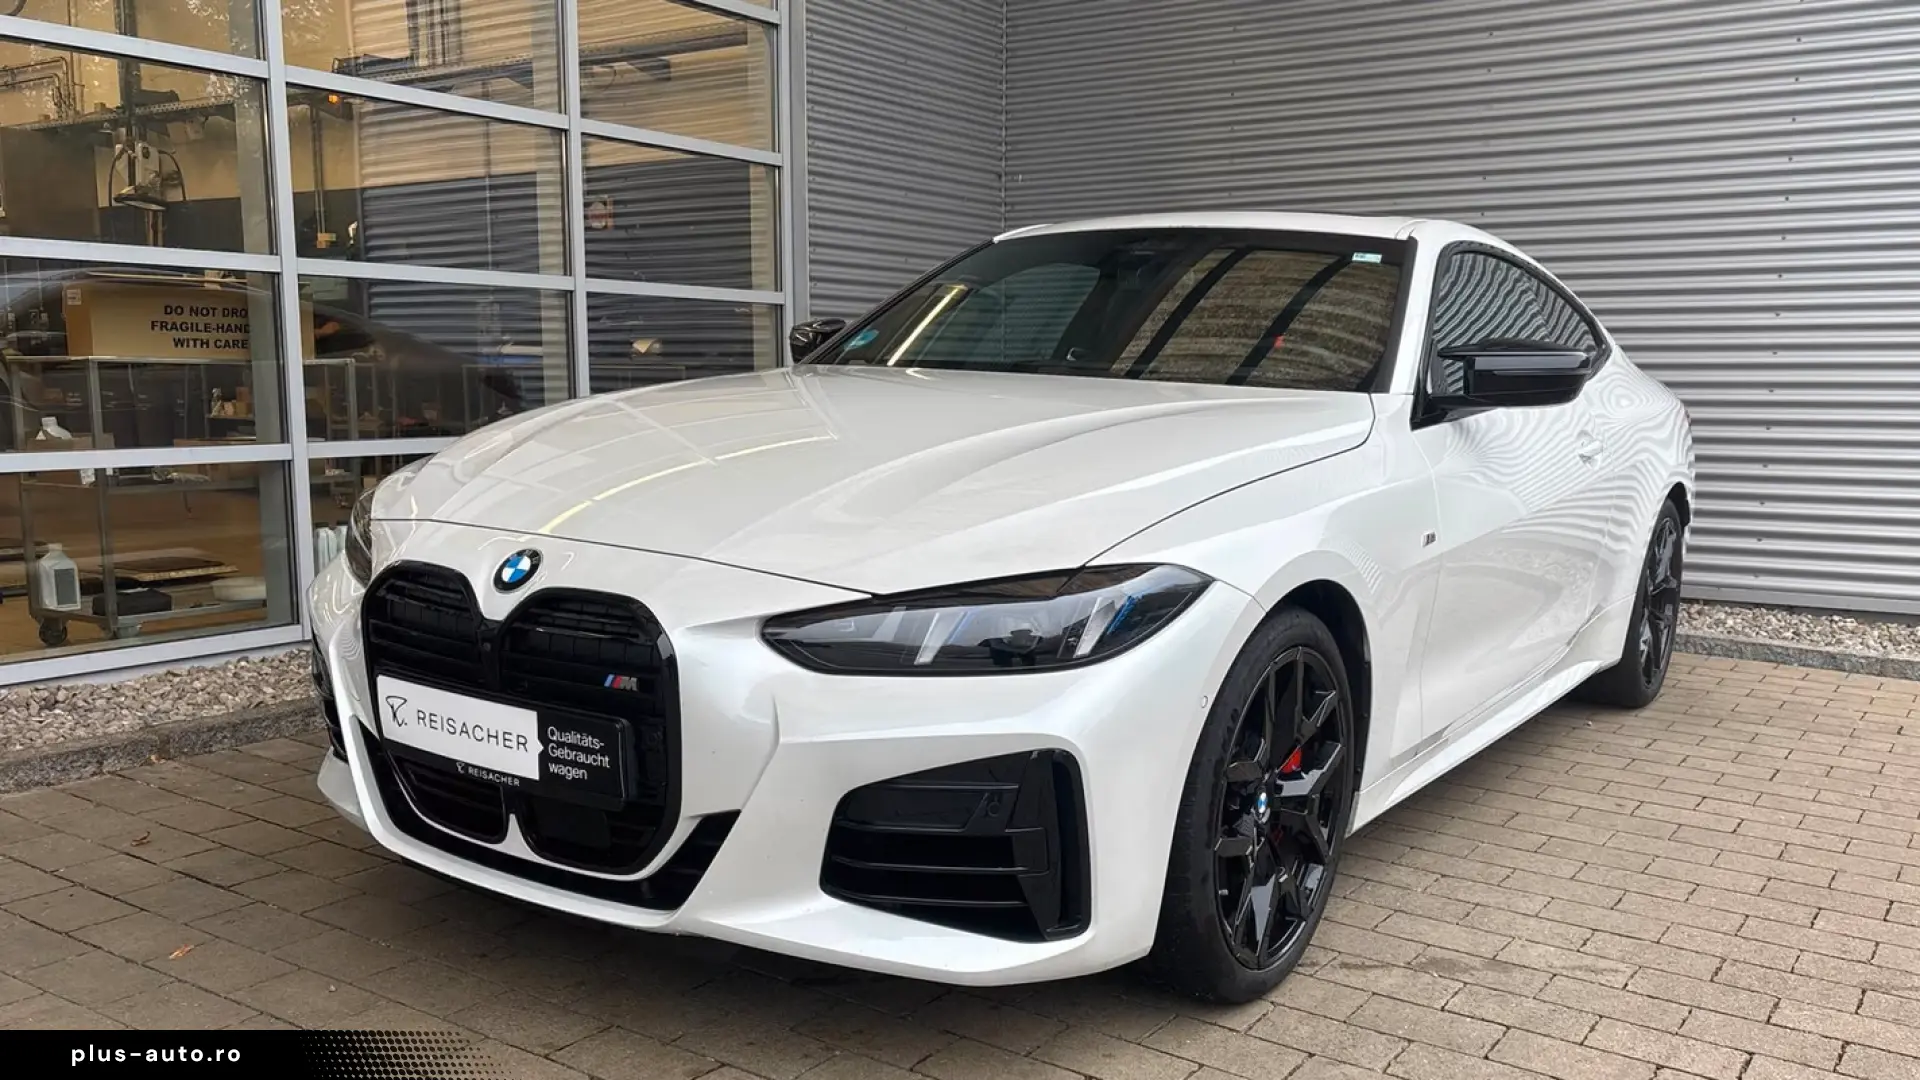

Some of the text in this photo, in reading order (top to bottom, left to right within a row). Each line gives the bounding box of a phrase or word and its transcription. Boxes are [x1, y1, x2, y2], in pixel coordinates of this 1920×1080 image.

[163, 304, 184, 316] DO
[189, 305, 218, 318] NOT
[173, 337, 250, 350] WITH CARE
[416, 709, 529, 753] REISACHER
[547, 726, 605, 750] Qualitäts-
[548, 742, 611, 768] Gebraucht
[468, 766, 520, 787] REISACHER
[548, 762, 588, 780] wagen
